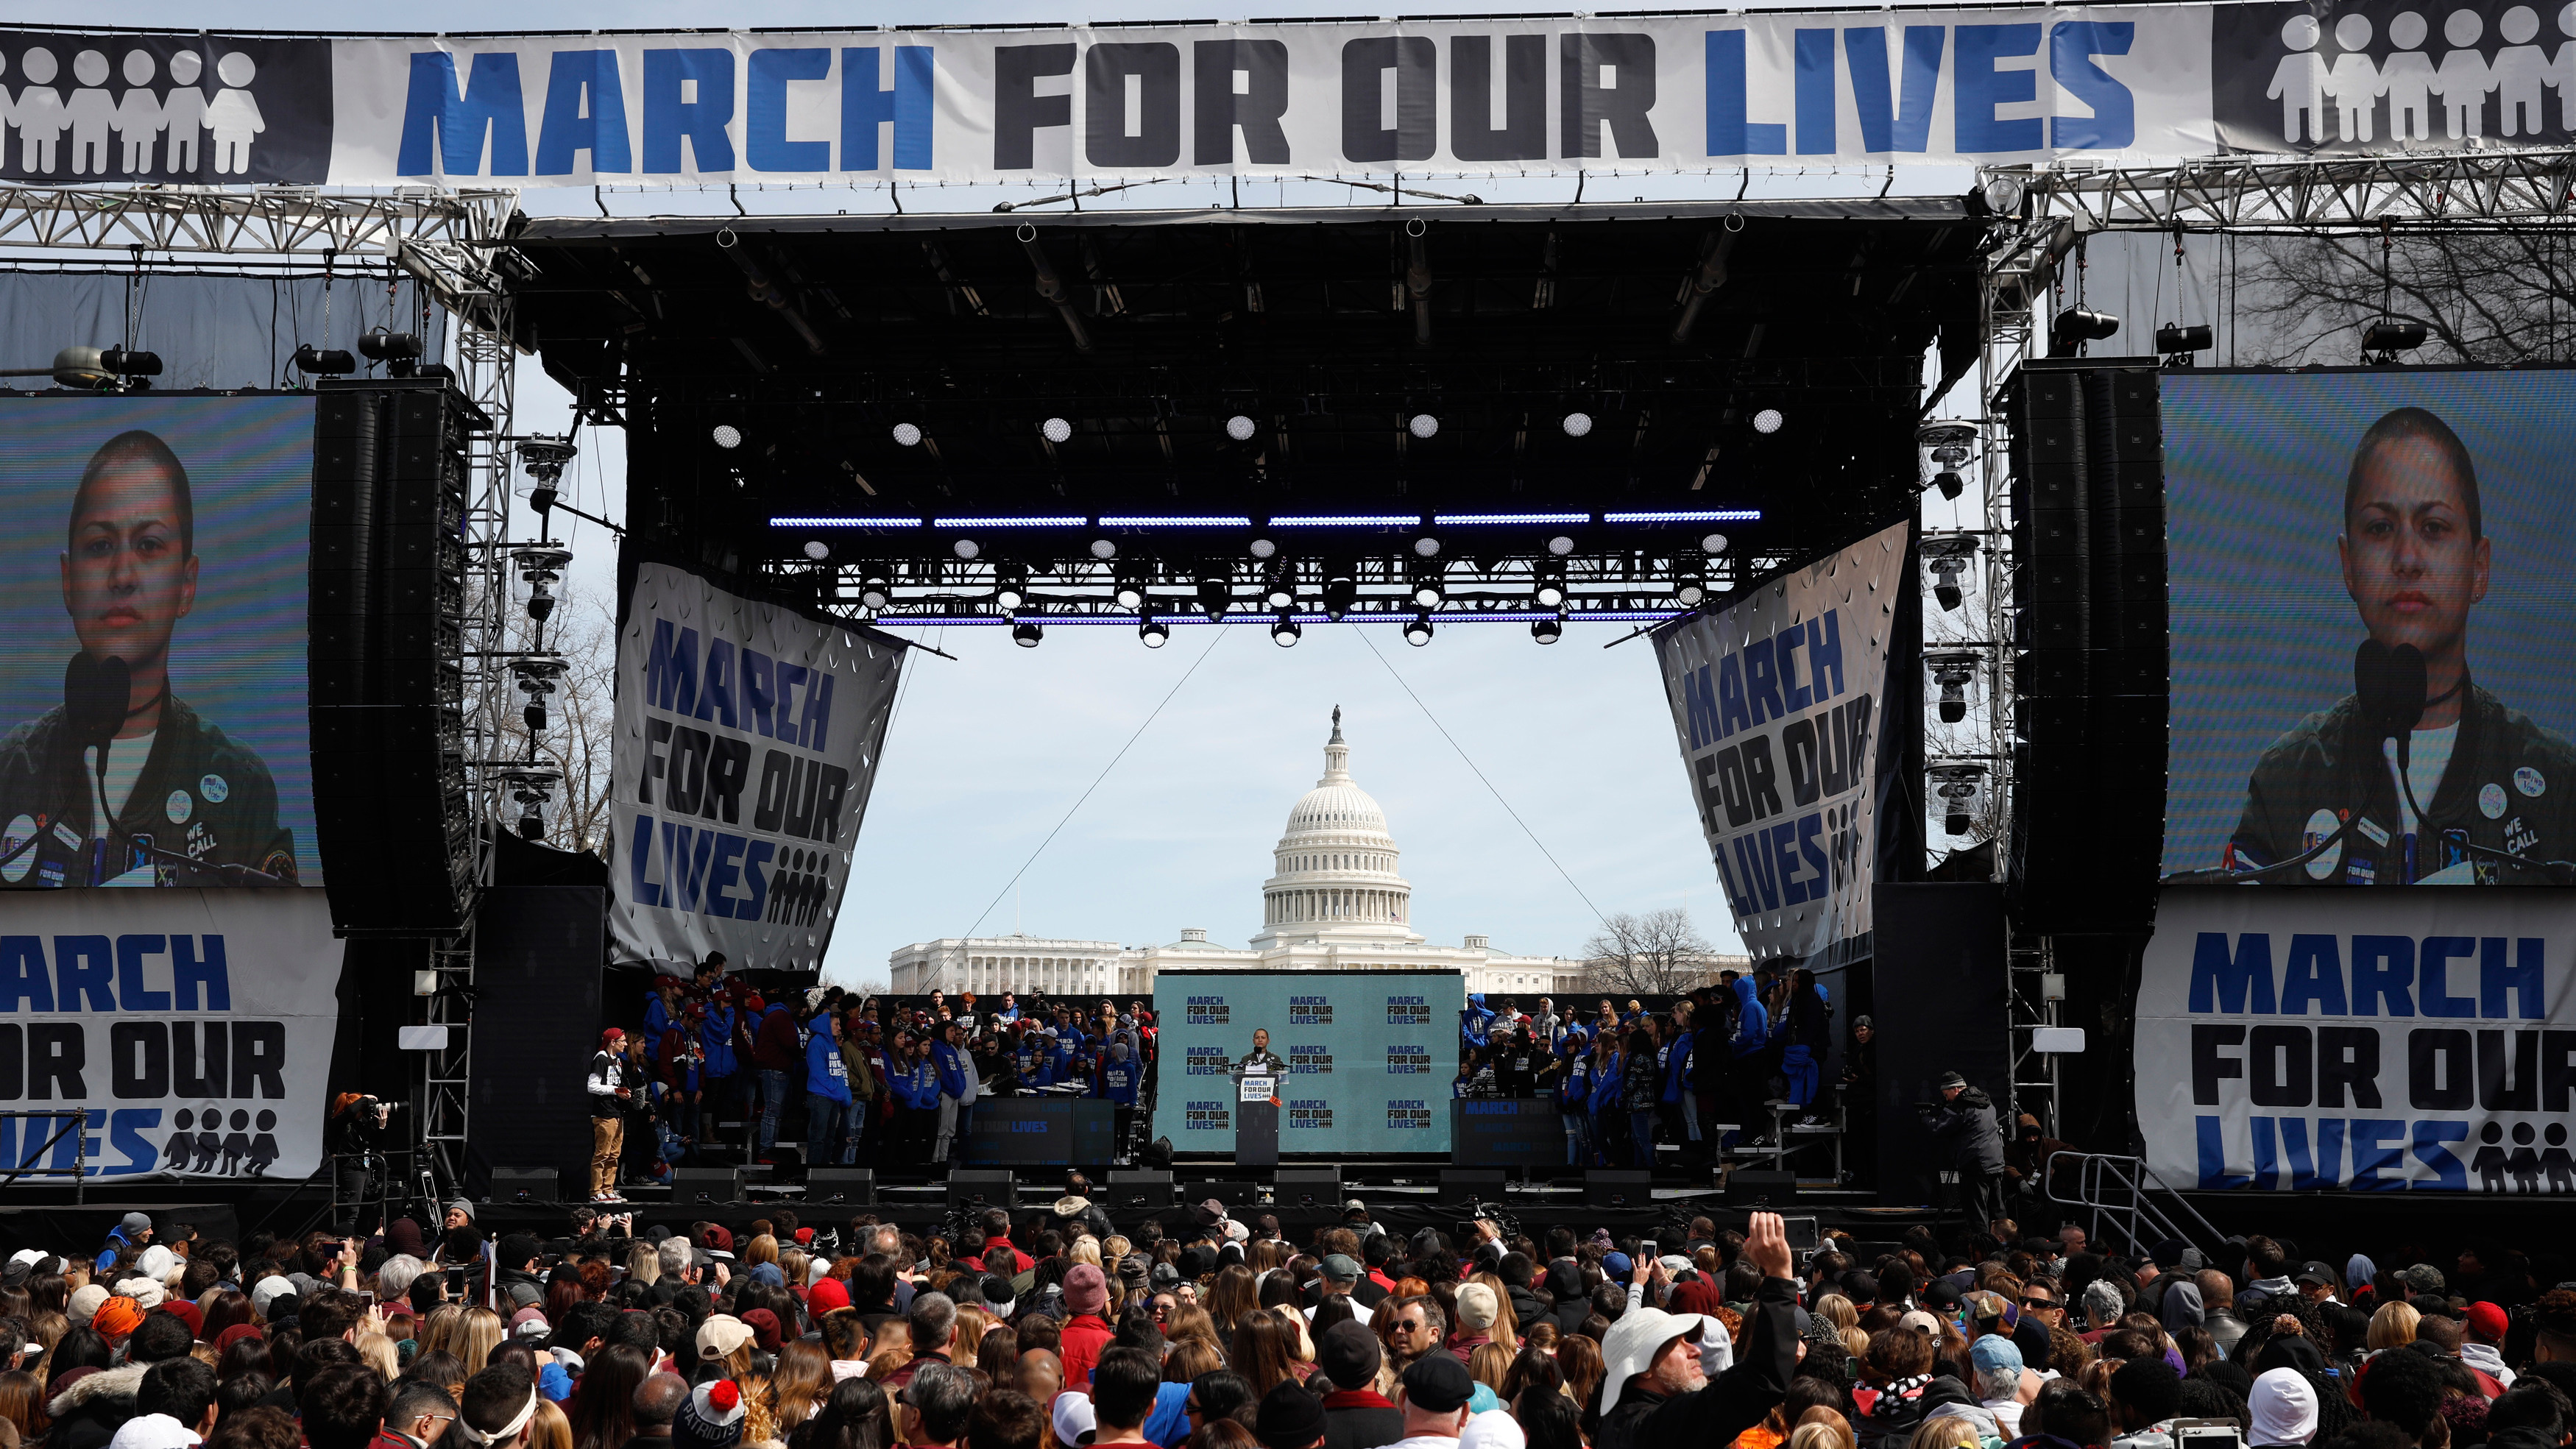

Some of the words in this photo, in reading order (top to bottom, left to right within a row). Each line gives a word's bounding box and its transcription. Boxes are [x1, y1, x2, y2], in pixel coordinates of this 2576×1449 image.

[397, 46, 933, 177] MARCH
[994, 40, 1290, 171] FOR
[1342, 33, 1659, 162] OUR
[1705, 21, 2135, 157] LIVES
[1683, 608, 1844, 751] MARCH
[647, 617, 835, 753] MARCH
[1694, 734, 1783, 835] FOR
[1783, 692, 1872, 808] OUR
[638, 715, 751, 825] FOR
[754, 748, 849, 844] OUR
[2523, 780, 2538, 795] Vote
[208, 787, 221, 801] Vote
[186, 821, 204, 841] WE
[2505, 816, 2523, 837] WE
[188, 834, 217, 857] CALL
[2507, 829, 2539, 854] CALL
[631, 814, 775, 922] LIVES
[1715, 812, 1828, 918] LIVES
[39, 868, 52, 879] FOR
[52, 871, 66, 882] OUR
[2347, 866, 2361, 876] FOR
[2360, 868, 2376, 879] OUR
[2188, 932, 2545, 1020] MARCH
[1187, 996, 1223, 1005] MARCH
[1290, 996, 1326, 1005] MARCH
[1387, 996, 1423, 1005] MARCH
[1187, 1006, 1206, 1015] FOR
[1209, 1006, 1229, 1015] OUR
[1290, 1006, 1309, 1015] FOR
[1312, 1006, 1332, 1015] OUR
[1387, 1006, 1407, 1015] FOR
[1409, 1006, 1430, 1015] OUR
[1187, 1016, 1214, 1024] LIVES
[1290, 1016, 1318, 1024] LIVES
[1387, 1016, 1416, 1024] LIVES
[1187, 1047, 1223, 1056] MARCH
[1290, 1046, 1326, 1055] MARCH
[1387, 1046, 1423, 1055] MARCH
[110, 1021, 286, 1099] OUR
[1187, 1057, 1206, 1066] FOR
[1209, 1057, 1229, 1066] OUR
[1290, 1055, 1309, 1064] FOR
[1312, 1055, 1332, 1064] OUR
[1387, 1055, 1407, 1064] FOR
[1409, 1055, 1430, 1064] OUR
[1187, 1066, 1214, 1075] LIVES
[1290, 1065, 1318, 1074] LIVES
[1387, 1065, 1416, 1074] LIVES
[2191, 1024, 2382, 1109] FOR
[1186, 1102, 1222, 1110] MARCH
[1290, 1100, 1326, 1109] MARCH
[1387, 1100, 1423, 1109] MARCH
[1465, 1101, 1518, 1115] MARCH
[1186, 1111, 1206, 1120] FOR
[1209, 1111, 1228, 1120] OUR
[1290, 1110, 1309, 1119] FOR
[1312, 1110, 1332, 1119] OUR
[1387, 1110, 1407, 1119] FOR
[1409, 1110, 1430, 1119] OUR
[1011, 1121, 1048, 1133] LIVES
[1186, 1121, 1214, 1130] LIVES
[1290, 1119, 1318, 1128] LIVES
[1387, 1119, 1416, 1128] LIVES
[2195, 1115, 2470, 1191] LIVES
[683, 1402, 737, 1441] PATRIOTS
